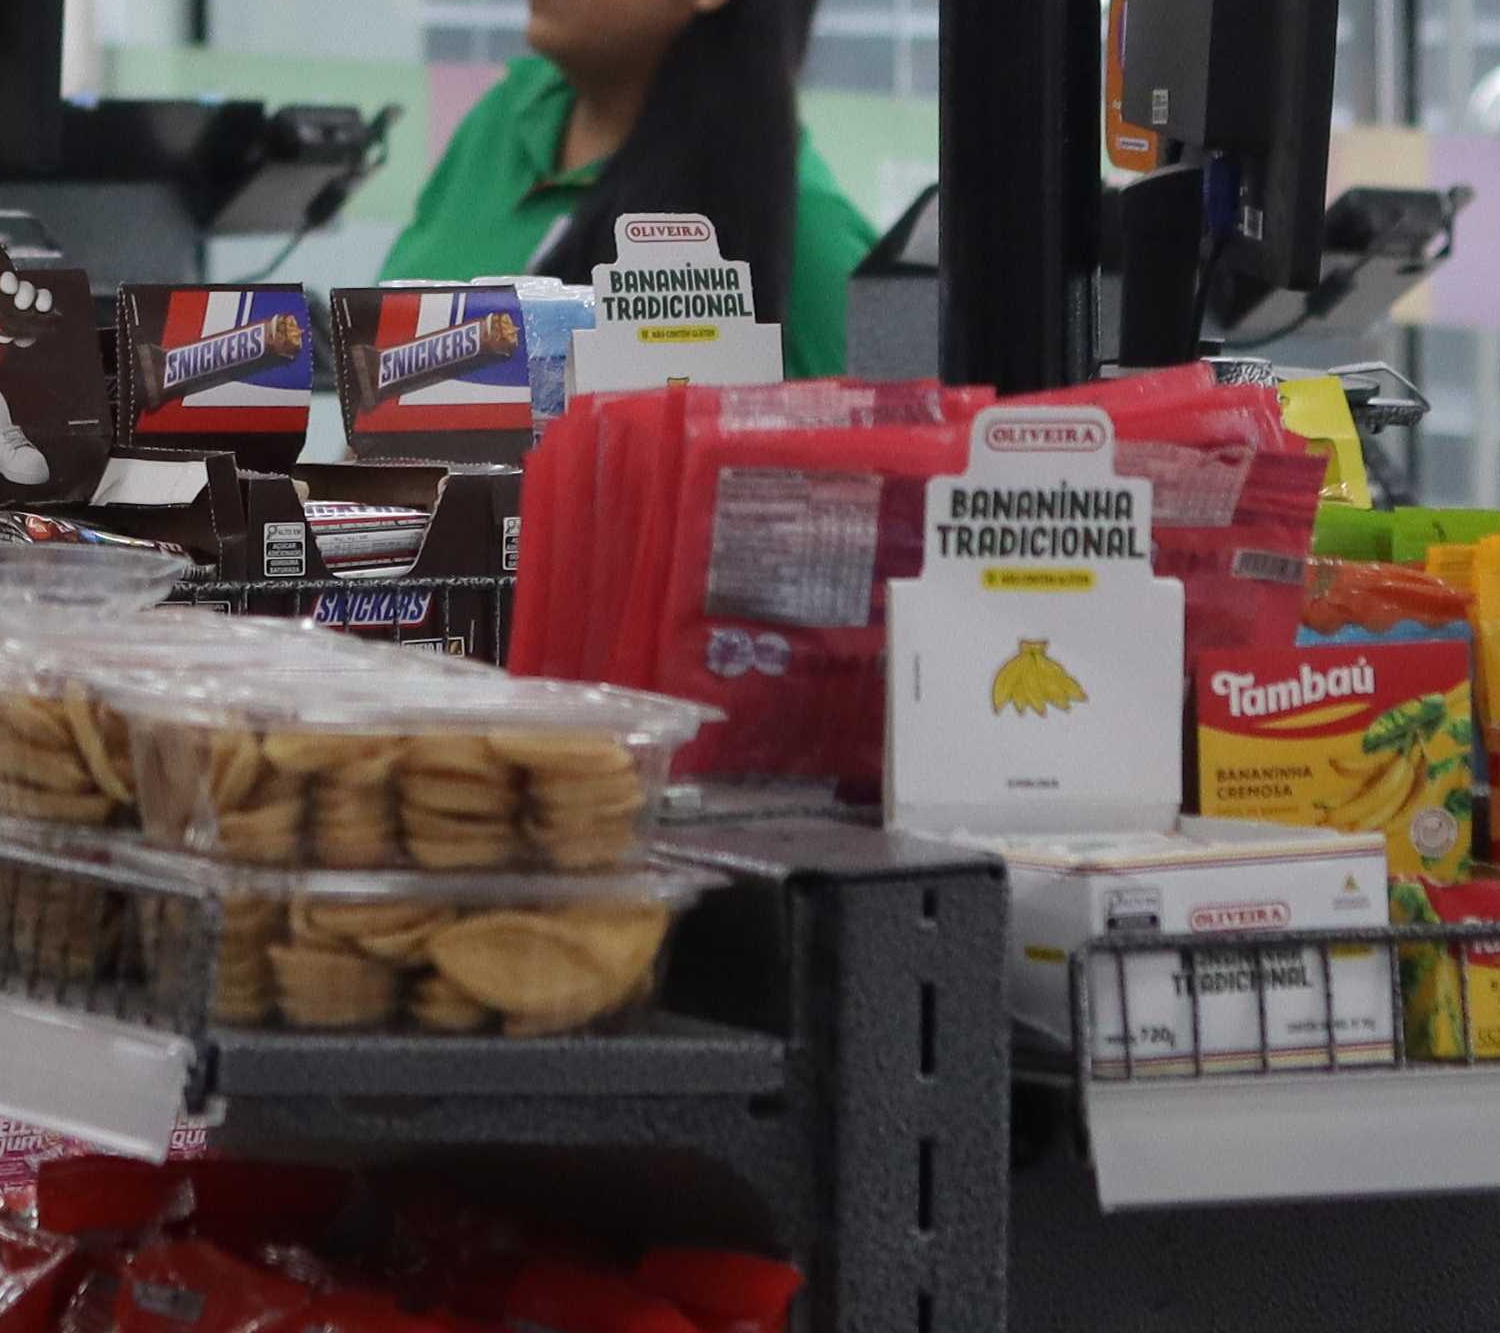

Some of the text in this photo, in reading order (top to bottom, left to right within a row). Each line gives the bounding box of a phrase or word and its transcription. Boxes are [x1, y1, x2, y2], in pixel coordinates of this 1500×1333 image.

[629, 225, 705, 238] OLIVEIRA
[602, 293, 753, 321] TRADICIONAL
[166, 327, 264, 383] SNICKERS
[380, 326, 479, 383] SNICKERS
[993, 426, 1096, 443] OLIVEIRA
[936, 524, 1146, 559] TRADICIONAL
[1210, 656, 1376, 717] Tambaú
